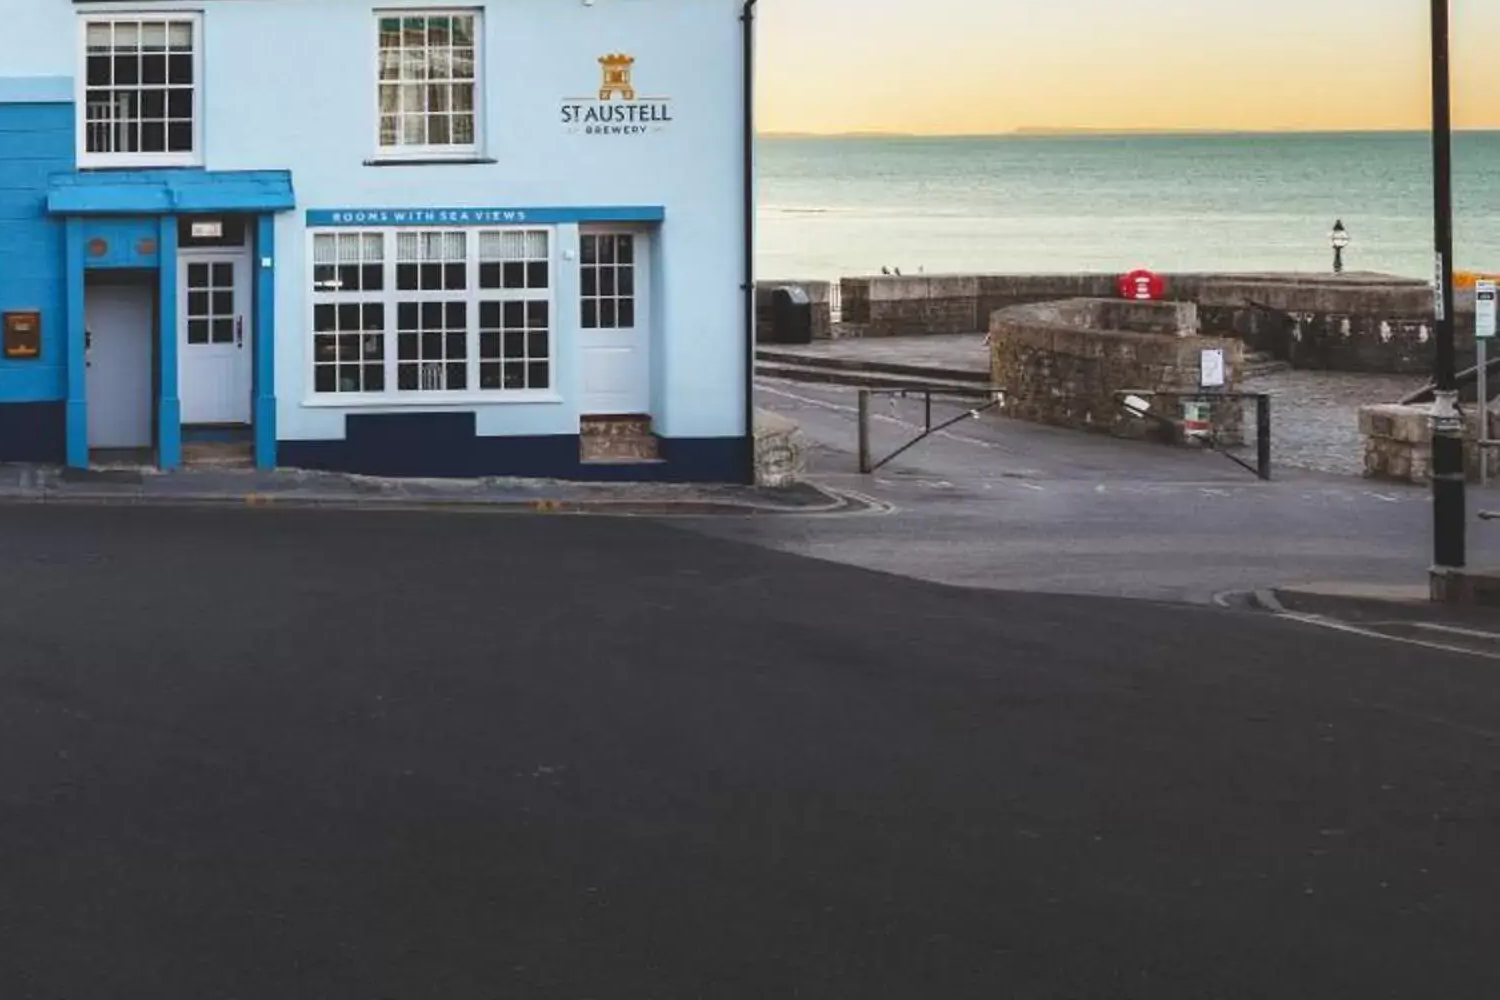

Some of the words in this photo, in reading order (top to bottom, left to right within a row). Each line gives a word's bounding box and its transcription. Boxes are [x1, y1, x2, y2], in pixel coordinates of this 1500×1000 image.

[584, 104, 673, 122] AUSTELL
[585, 125, 648, 134] BREWERY
[332, 211, 389, 222] ROOMS
[393, 211, 435, 222] WITH
[439, 210, 471, 221] SEA
[475, 210, 527, 221] VIEWS
